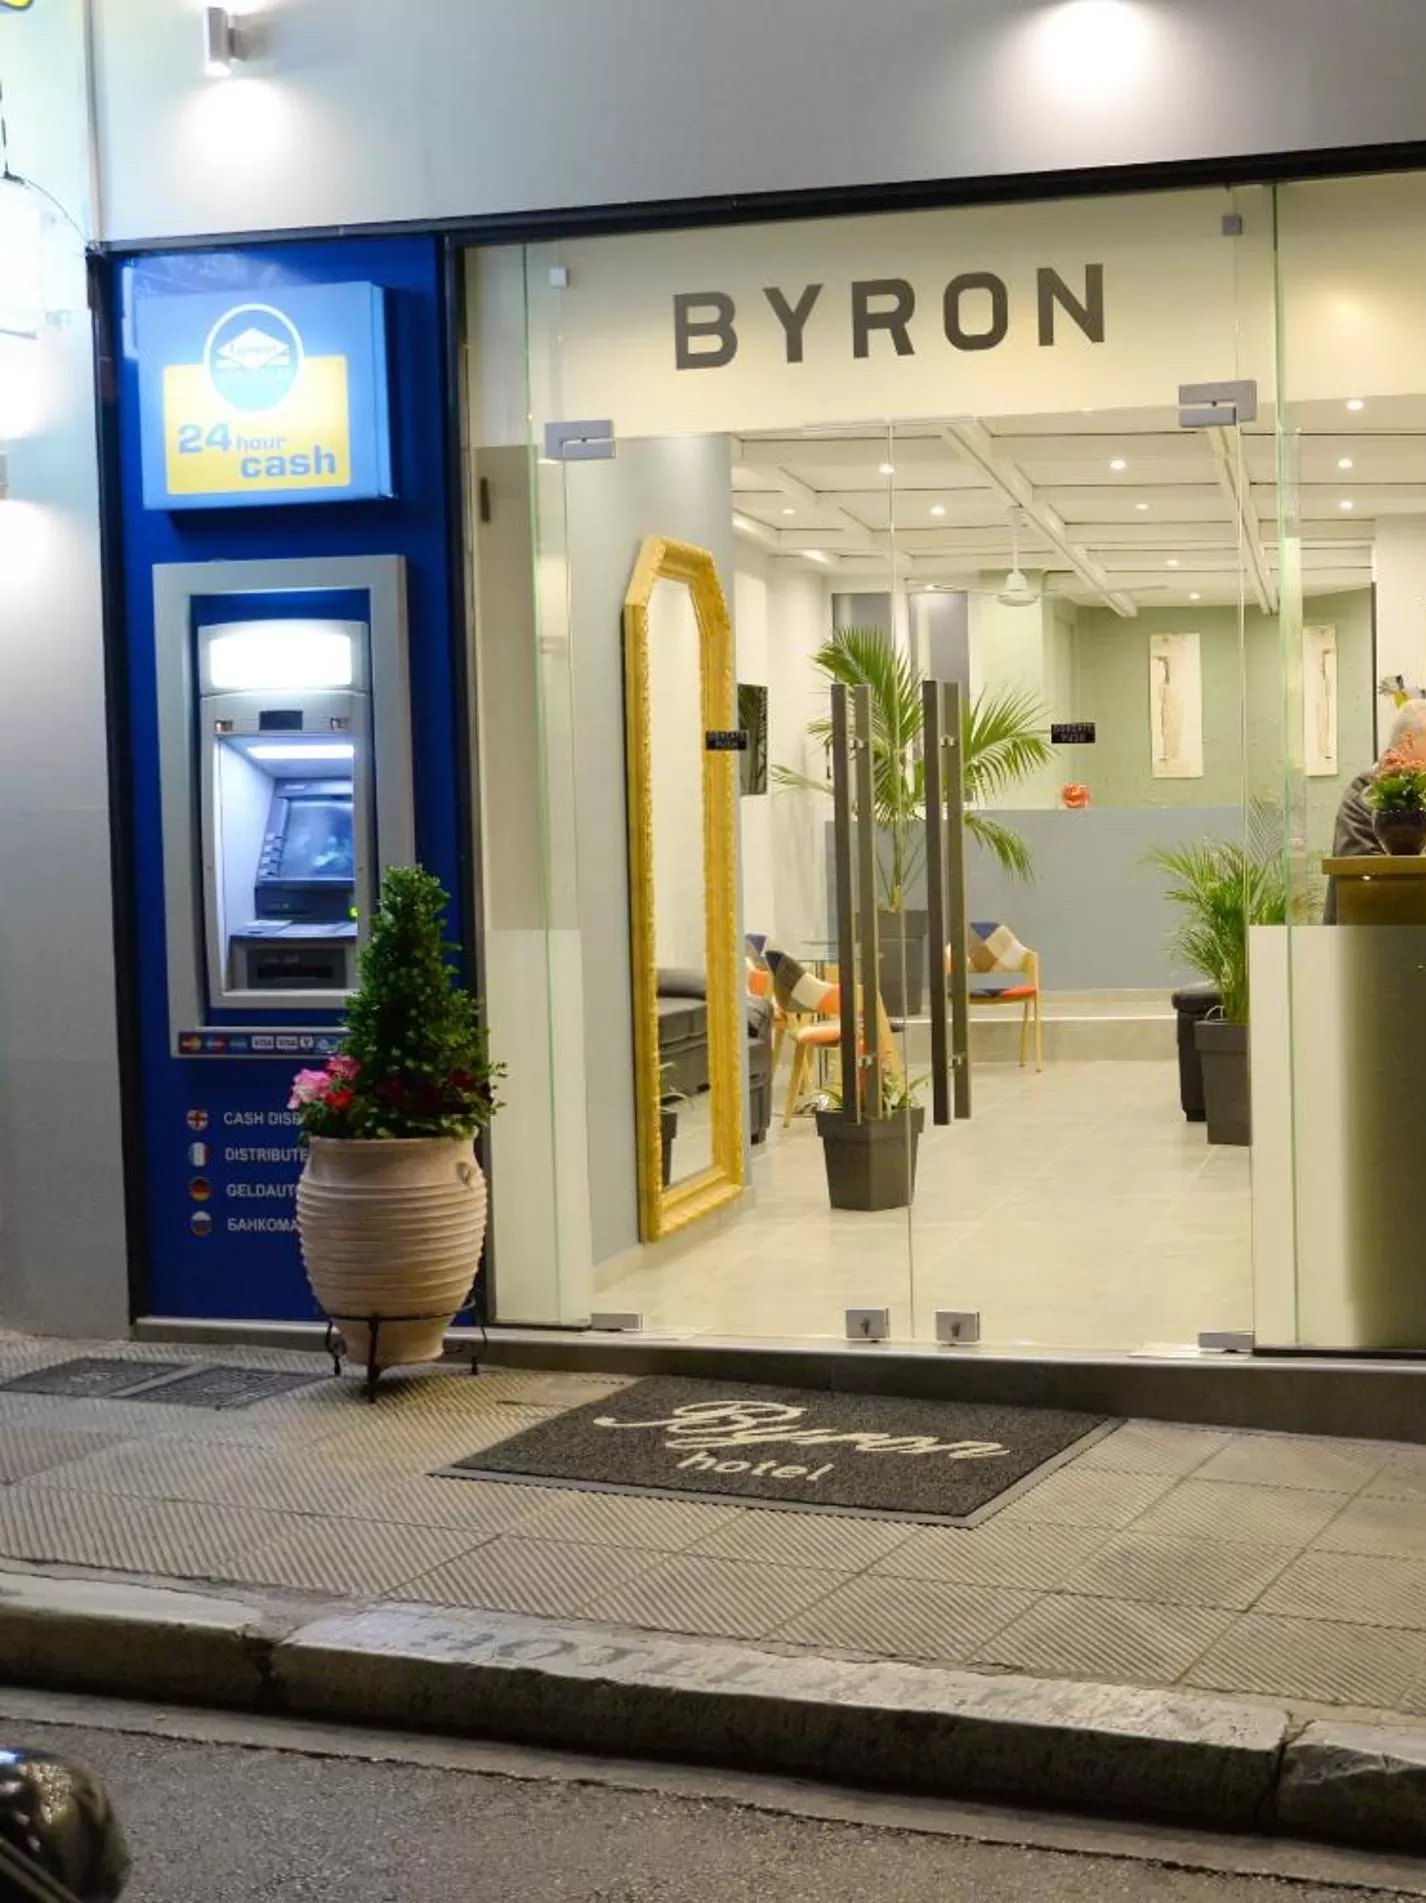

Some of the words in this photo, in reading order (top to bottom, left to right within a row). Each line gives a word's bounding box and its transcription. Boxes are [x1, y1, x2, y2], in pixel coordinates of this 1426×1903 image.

[674, 263, 1105, 370] BYRON
[177, 423, 232, 455] 24
[236, 435, 288, 450] hour
[241, 444, 336, 478] cash
[223, 1111, 264, 1126] CASH
[267, 1111, 304, 1126] DISP
[225, 1147, 310, 1162] DISTRIBUTE
[226, 1183, 299, 1197] GELDAUT
[227, 1217, 300, 1232] БАНКОМА
[593, 1400, 1011, 1459] Byron
[676, 1450, 833, 1482] hotel
